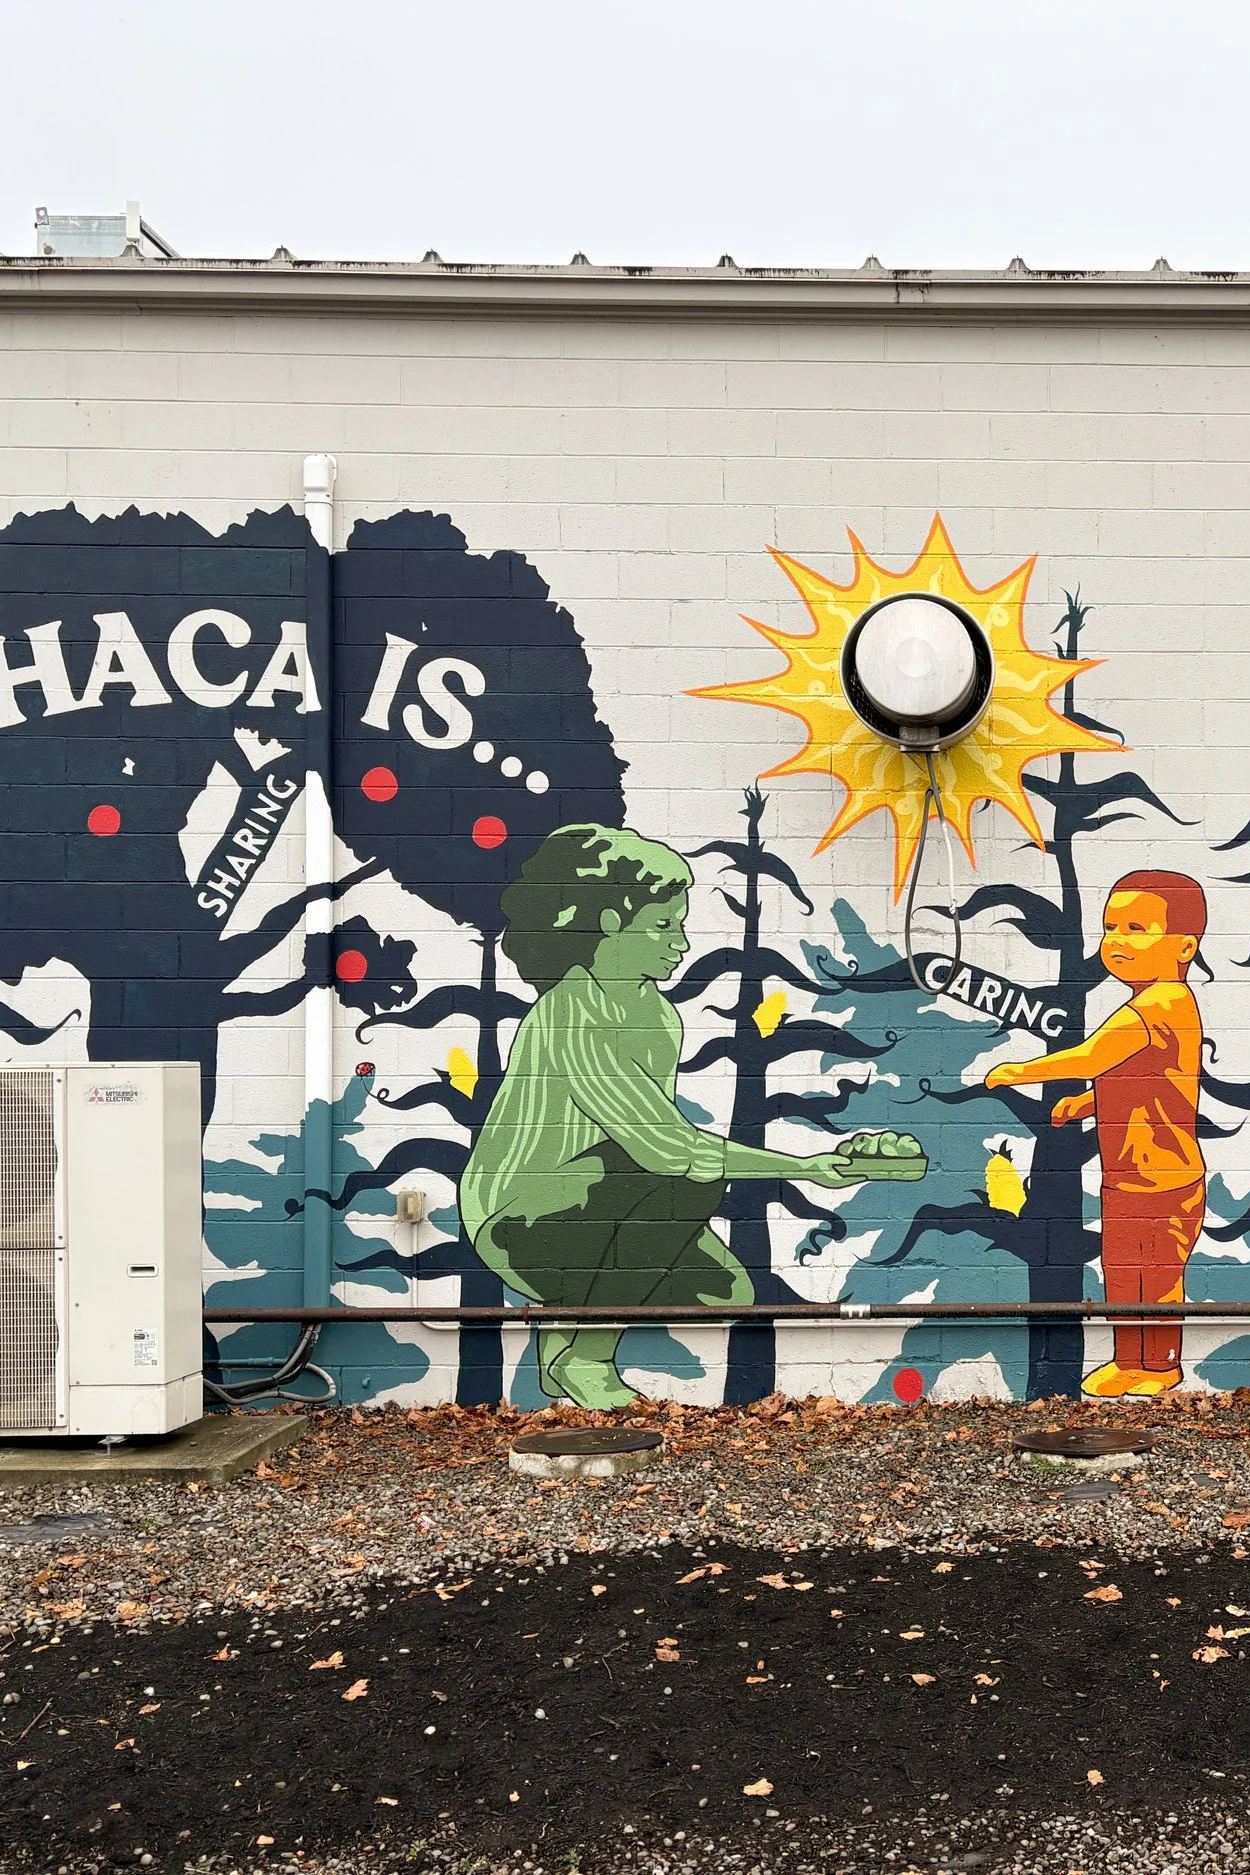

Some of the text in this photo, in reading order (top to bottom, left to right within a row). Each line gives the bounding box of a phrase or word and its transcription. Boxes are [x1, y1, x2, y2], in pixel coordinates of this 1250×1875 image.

[0, 608, 322, 728] HACA
[197, 773, 298, 918] SHARING
[924, 957, 1068, 1038] CARING
